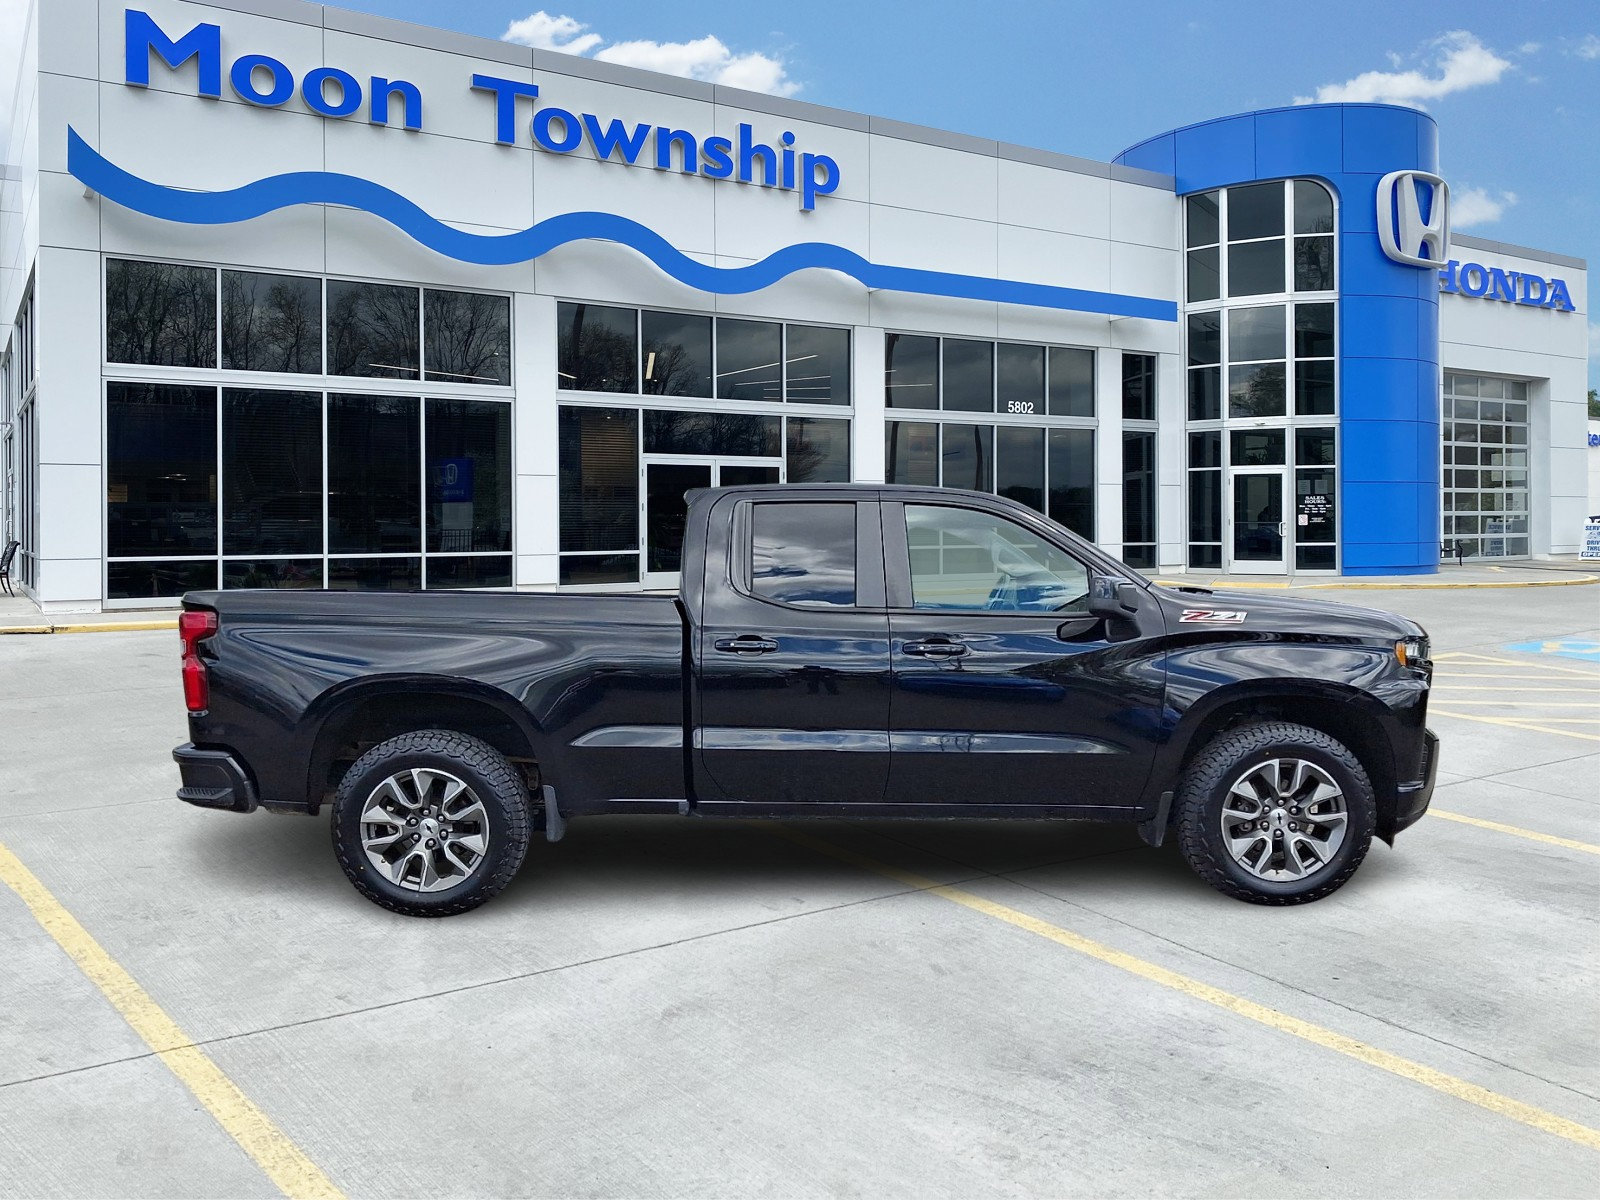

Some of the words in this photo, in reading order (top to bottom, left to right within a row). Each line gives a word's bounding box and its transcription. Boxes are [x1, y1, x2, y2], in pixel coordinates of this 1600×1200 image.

[124, 8, 422, 132] Moon
[469, 73, 840, 214] Township
[1007, 400, 1034, 414] 5802
[1179, 609, 1248, 624] Z71
